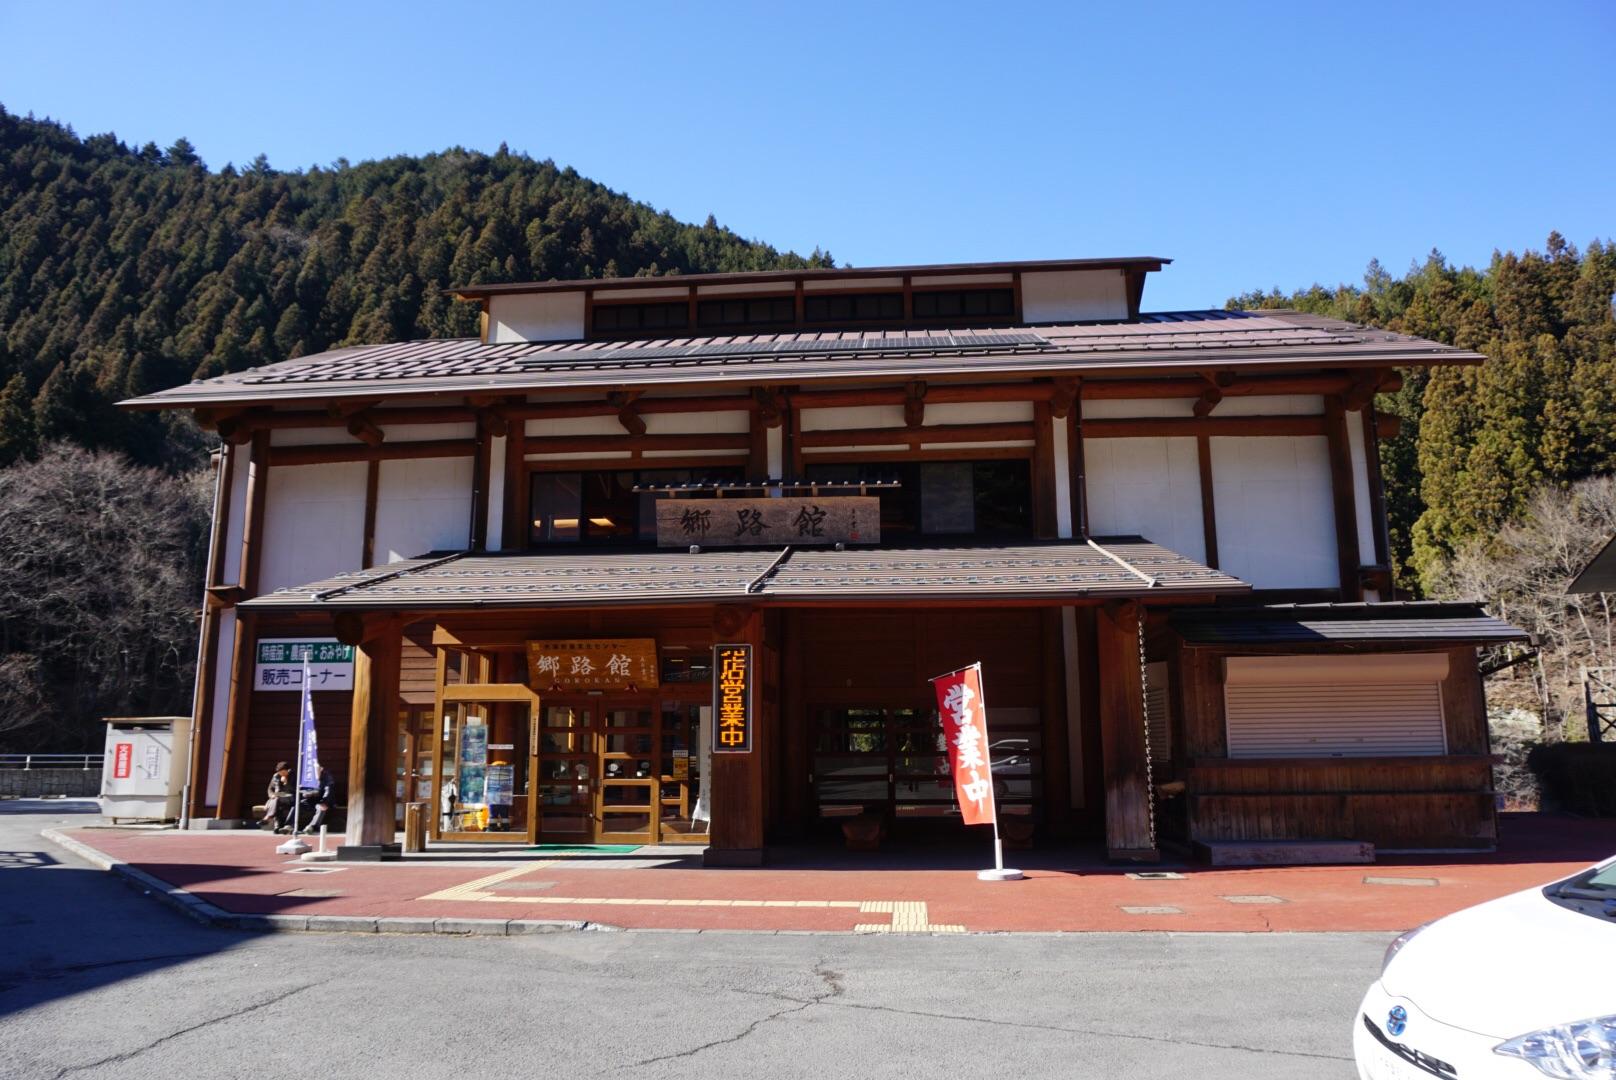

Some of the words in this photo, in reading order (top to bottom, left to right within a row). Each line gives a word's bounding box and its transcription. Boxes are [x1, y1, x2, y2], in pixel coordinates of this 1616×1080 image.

[680, 505, 826, 537] 郷路館
[262, 668, 346, 685] 販売コーナー
[536, 653, 632, 678] 郷路館
[943, 683, 989, 815] 営業中
